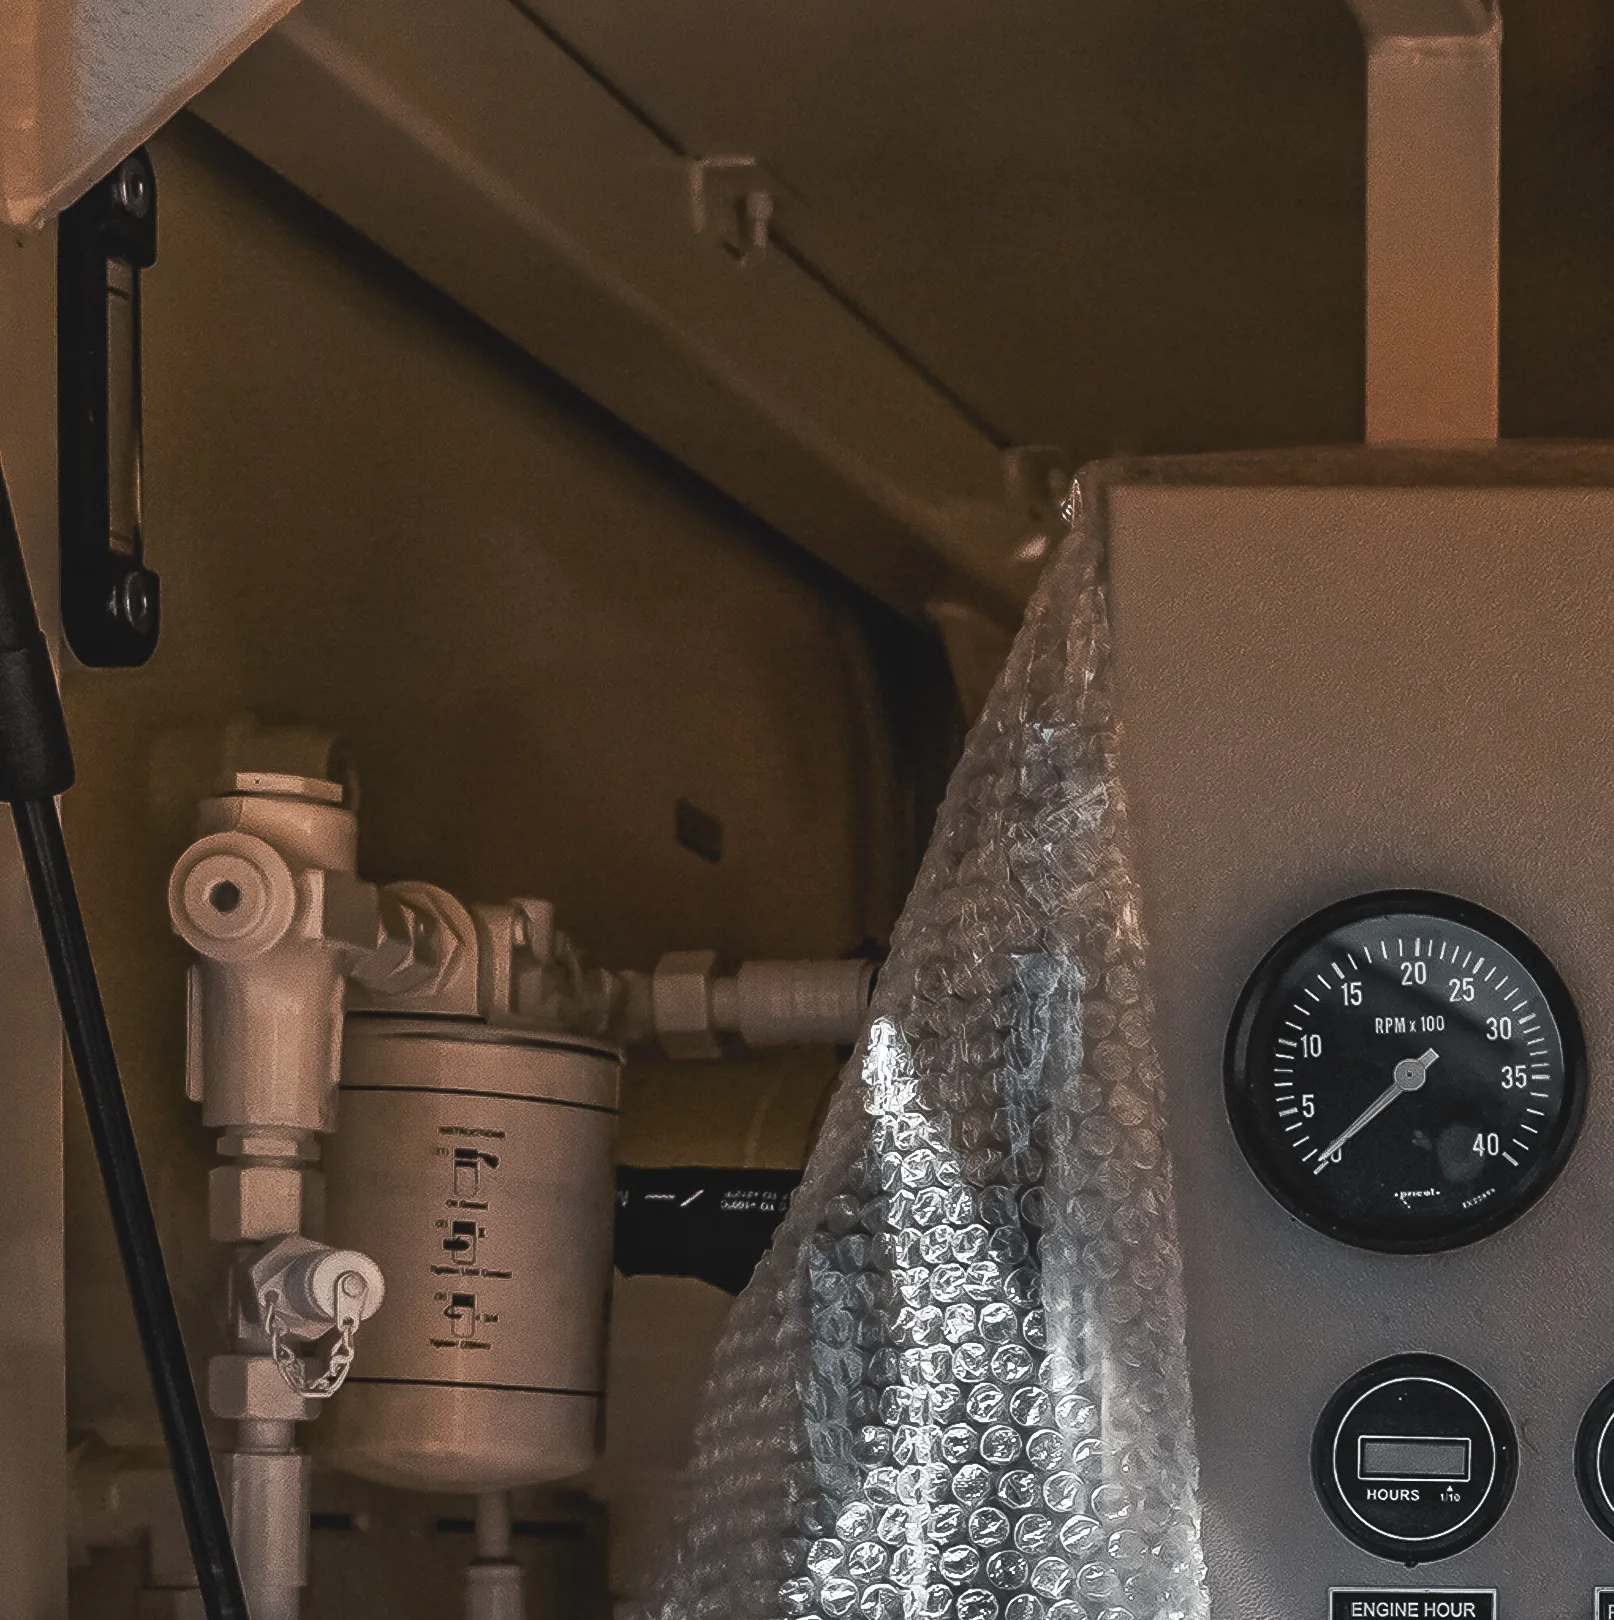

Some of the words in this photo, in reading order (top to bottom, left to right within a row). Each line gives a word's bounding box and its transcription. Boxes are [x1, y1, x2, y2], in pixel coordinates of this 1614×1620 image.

[1401, 962, 1427, 985] 20
[1340, 982, 1363, 1006] 15
[1449, 978, 1475, 1002] 25
[1375, 1017, 1406, 1034] RPM
[1420, 1015, 1445, 1032] 100
[1486, 1017, 1512, 1040] 30
[1301, 1035, 1322, 1058] 10
[1501, 1065, 1527, 1089] 35
[1302, 1094, 1315, 1118] 5
[1473, 1133, 1499, 1157] 40
[1366, 1488, 1420, 1502] HOURS
[1351, 1601, 1419, 1618] ENGINE
[1423, 1601, 1476, 1618] HOUR
